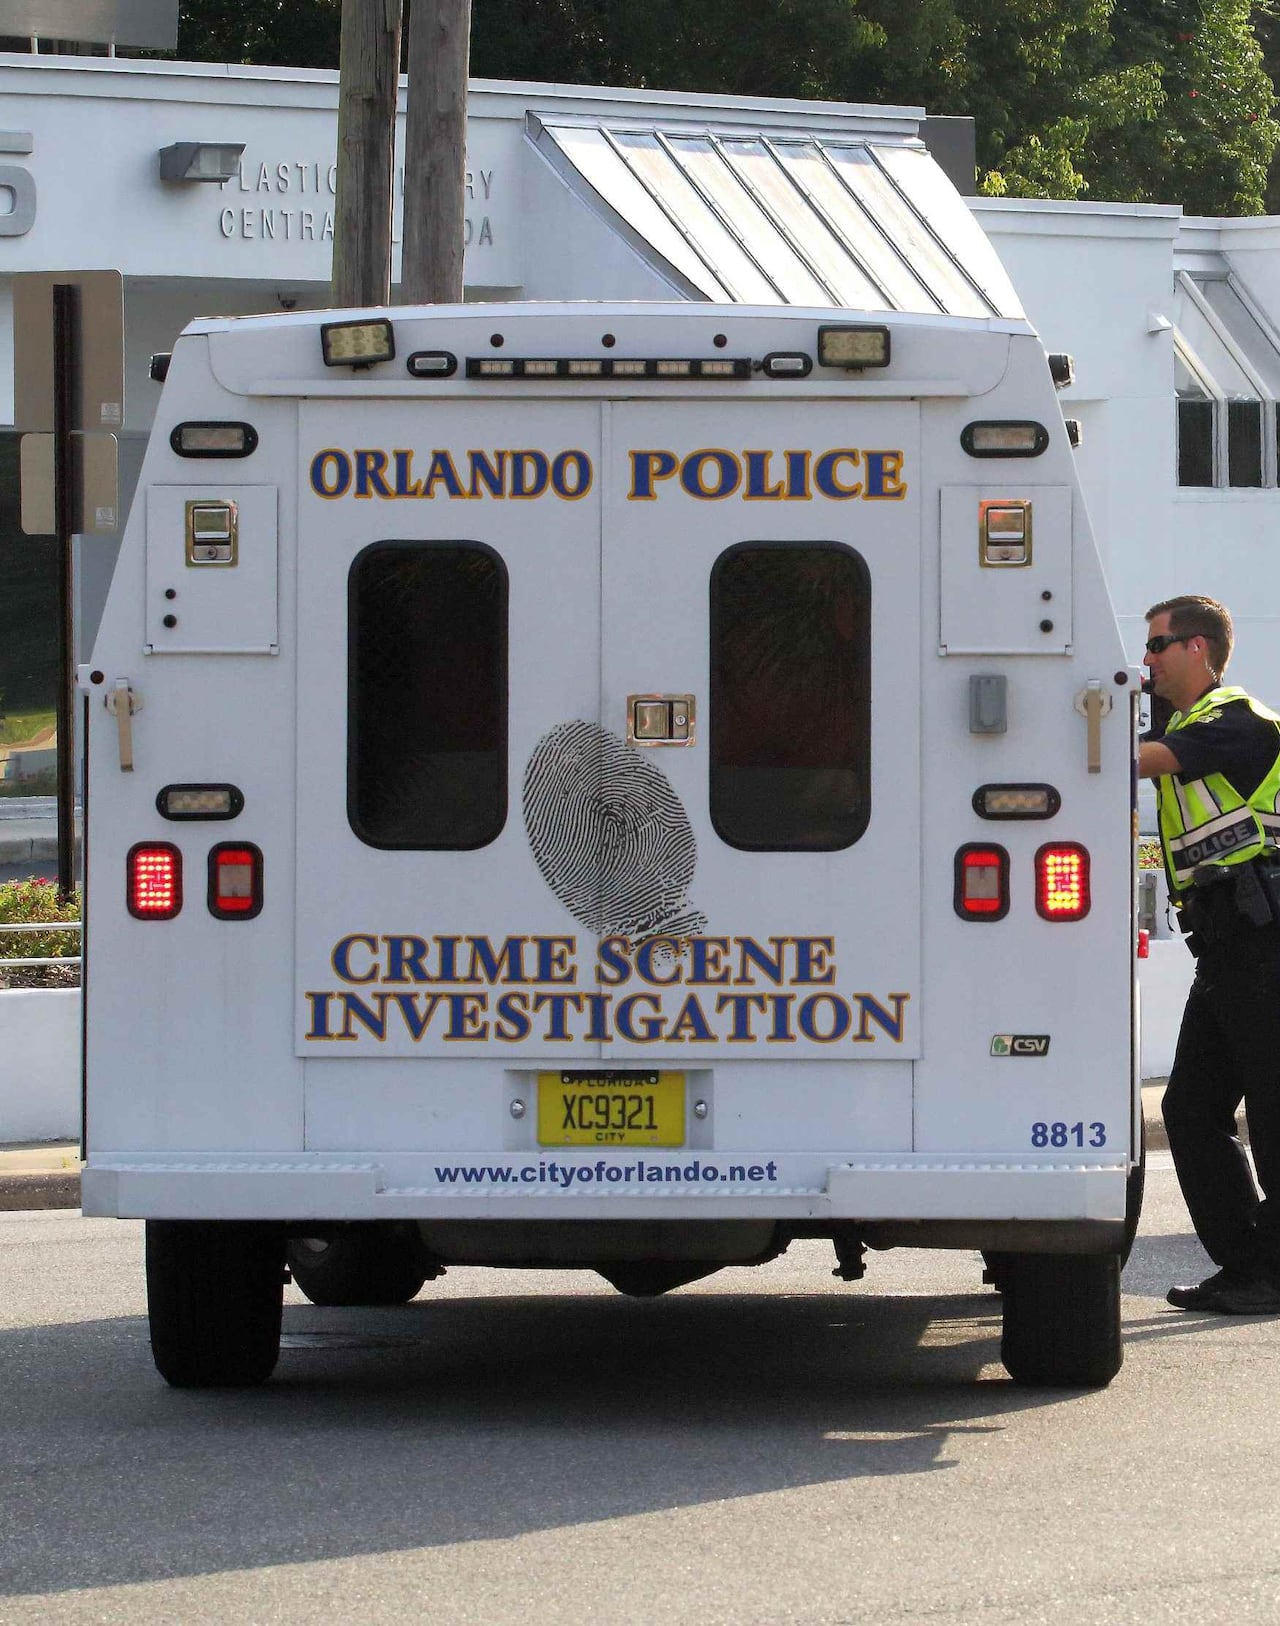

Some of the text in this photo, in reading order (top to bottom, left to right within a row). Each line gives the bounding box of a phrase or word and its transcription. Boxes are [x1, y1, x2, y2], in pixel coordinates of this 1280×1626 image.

[309, 448, 908, 501] ORLANDO POLICE
[331, 933, 836, 986] CRIME SCENE
[304, 991, 911, 1043] INVESTIGATION
[1013, 1039, 1047, 1053] CSV
[562, 1094, 658, 1130] XC9321
[595, 1132, 626, 1142] CITY
[1031, 1121, 1107, 1148] 8813
[434, 1160, 778, 1188] www.cityoforlando.net
